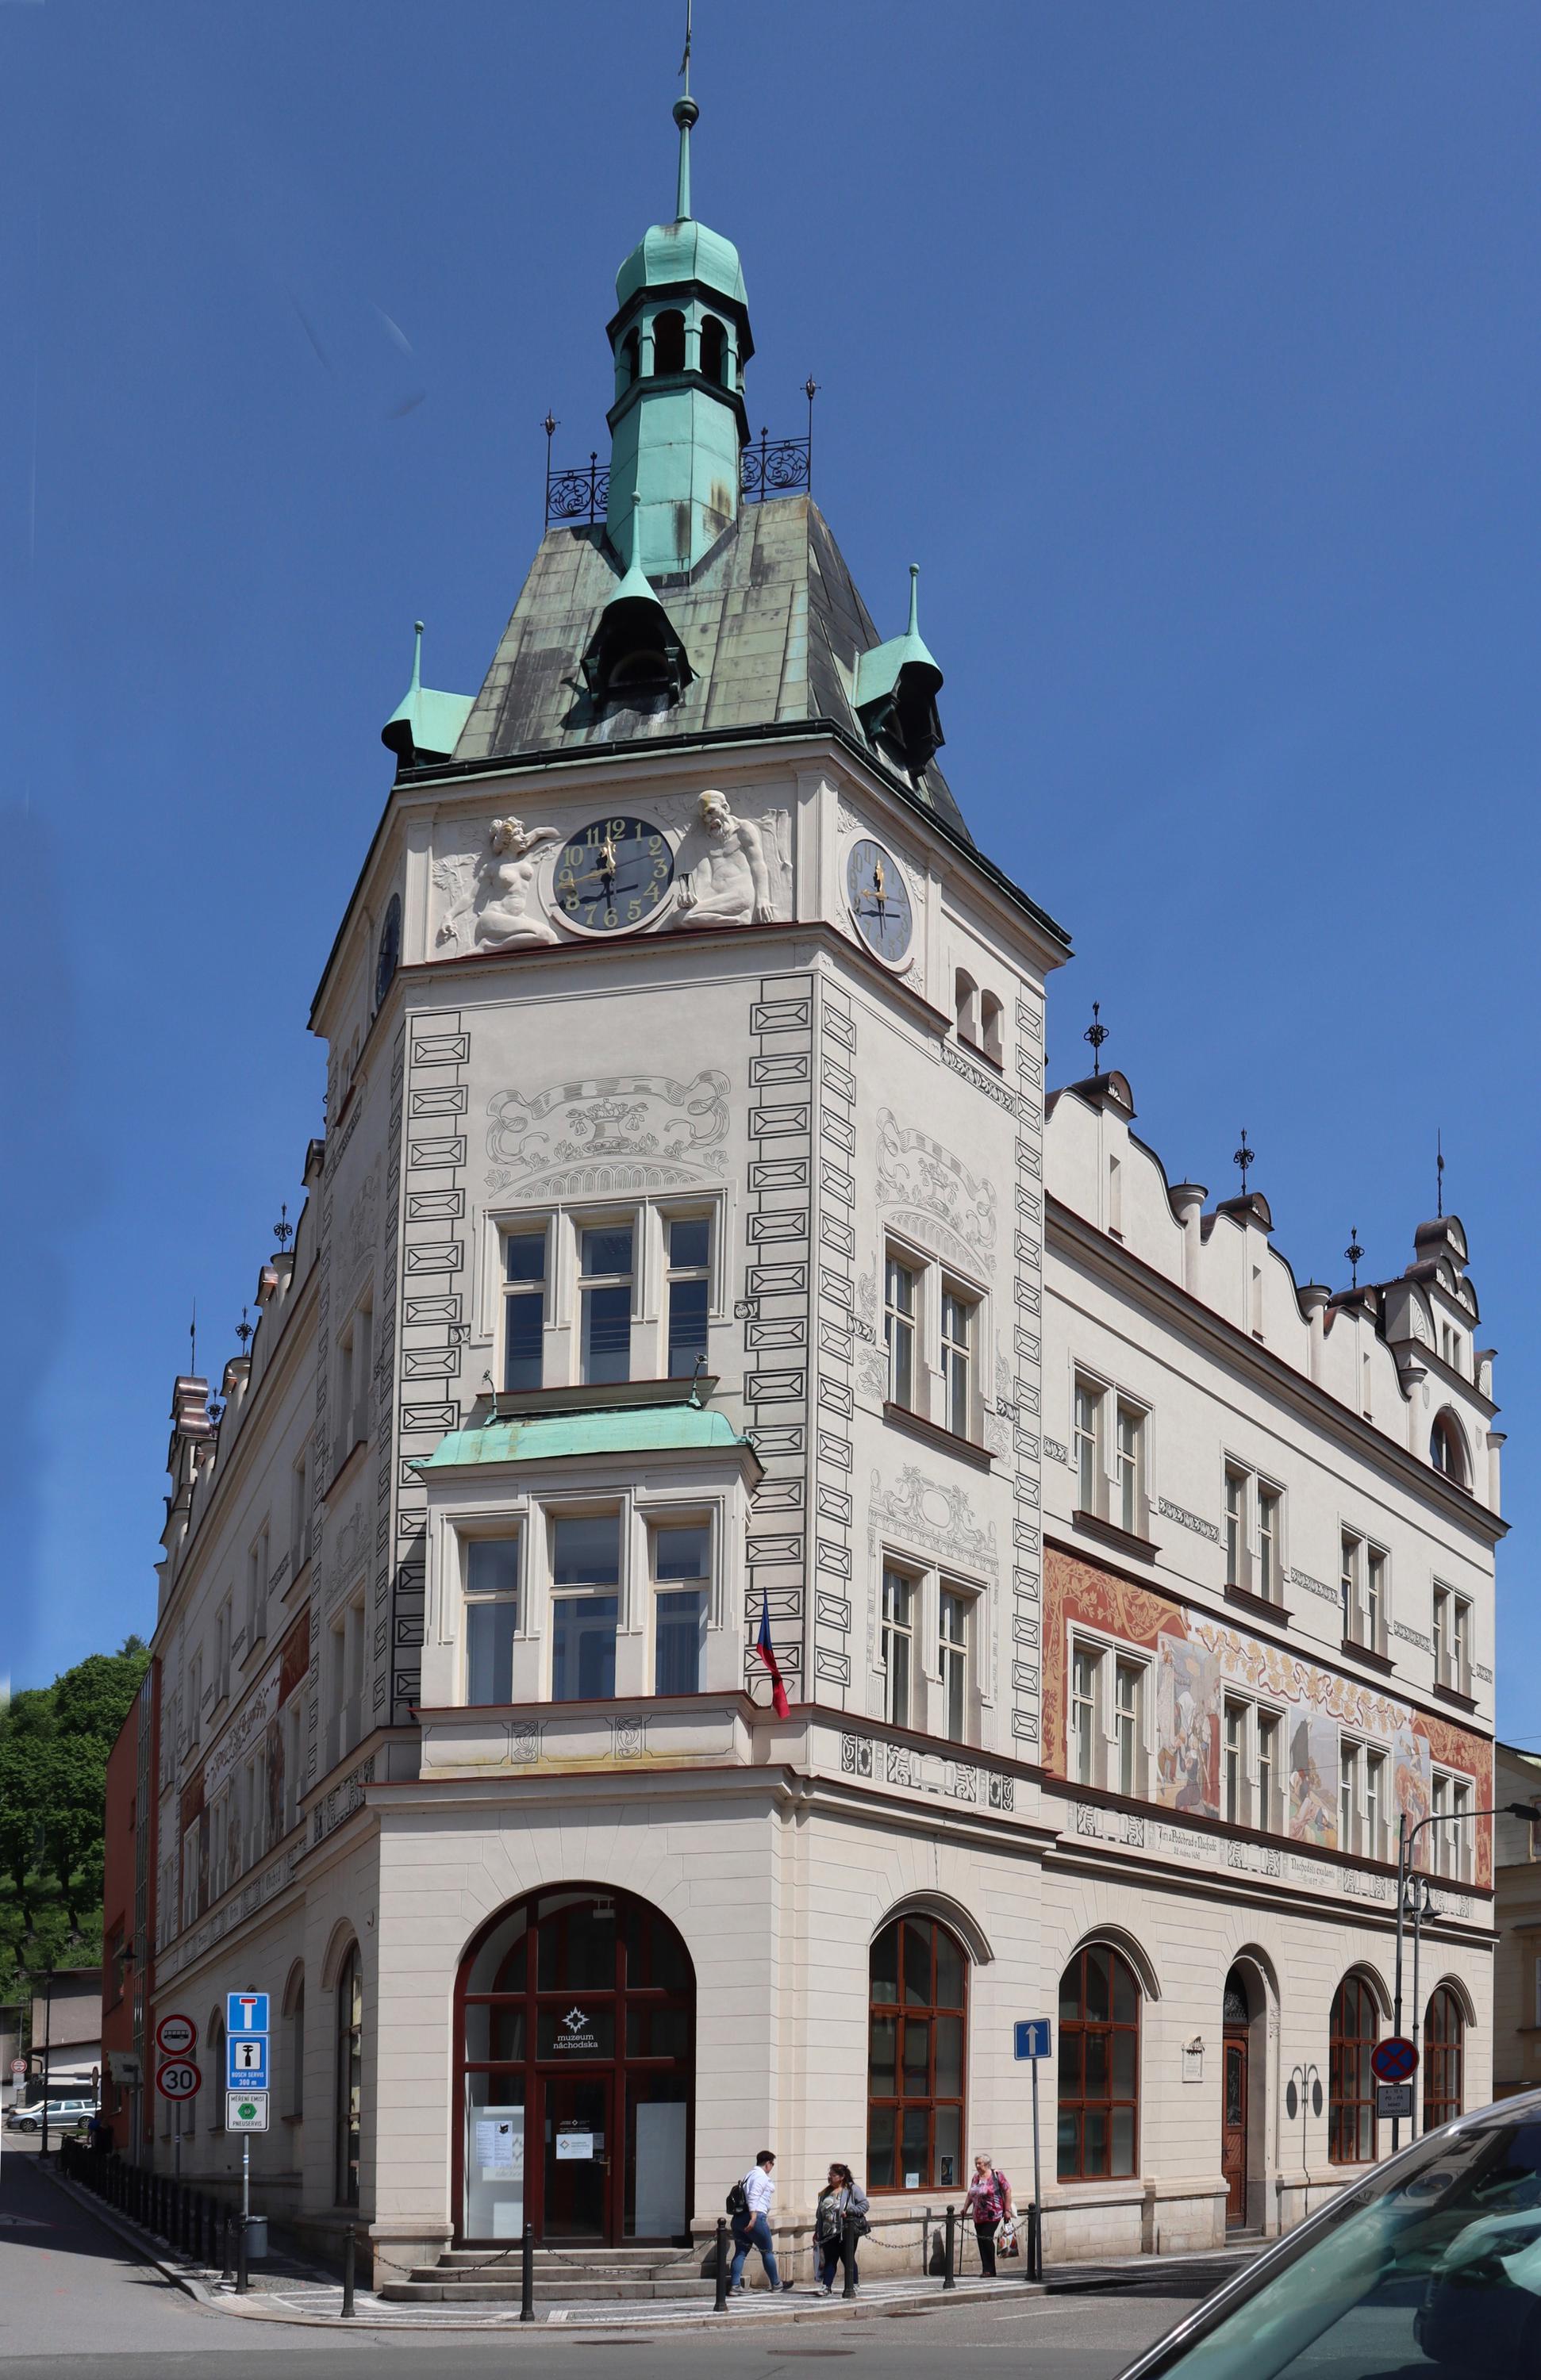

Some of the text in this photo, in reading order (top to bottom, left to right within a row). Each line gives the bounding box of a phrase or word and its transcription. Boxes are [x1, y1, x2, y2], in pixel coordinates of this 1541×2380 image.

[586, 827, 599, 848] 11
[605, 820, 626, 841] 12
[635, 823, 643, 843] 1
[648, 835, 662, 855] 2
[563, 846, 583, 866] 10
[853, 850, 863, 873] 10
[653, 858, 668, 878] 3
[559, 869, 574, 889] 9
[565, 890, 580, 911] 8
[644, 881, 660, 902] 4
[584, 904, 598, 925] 7
[603, 908, 618, 927] 6
[628, 899, 642, 920] 5
[553, 2040, 598, 2049] náchodska
[166, 2070, 192, 2090] 30
